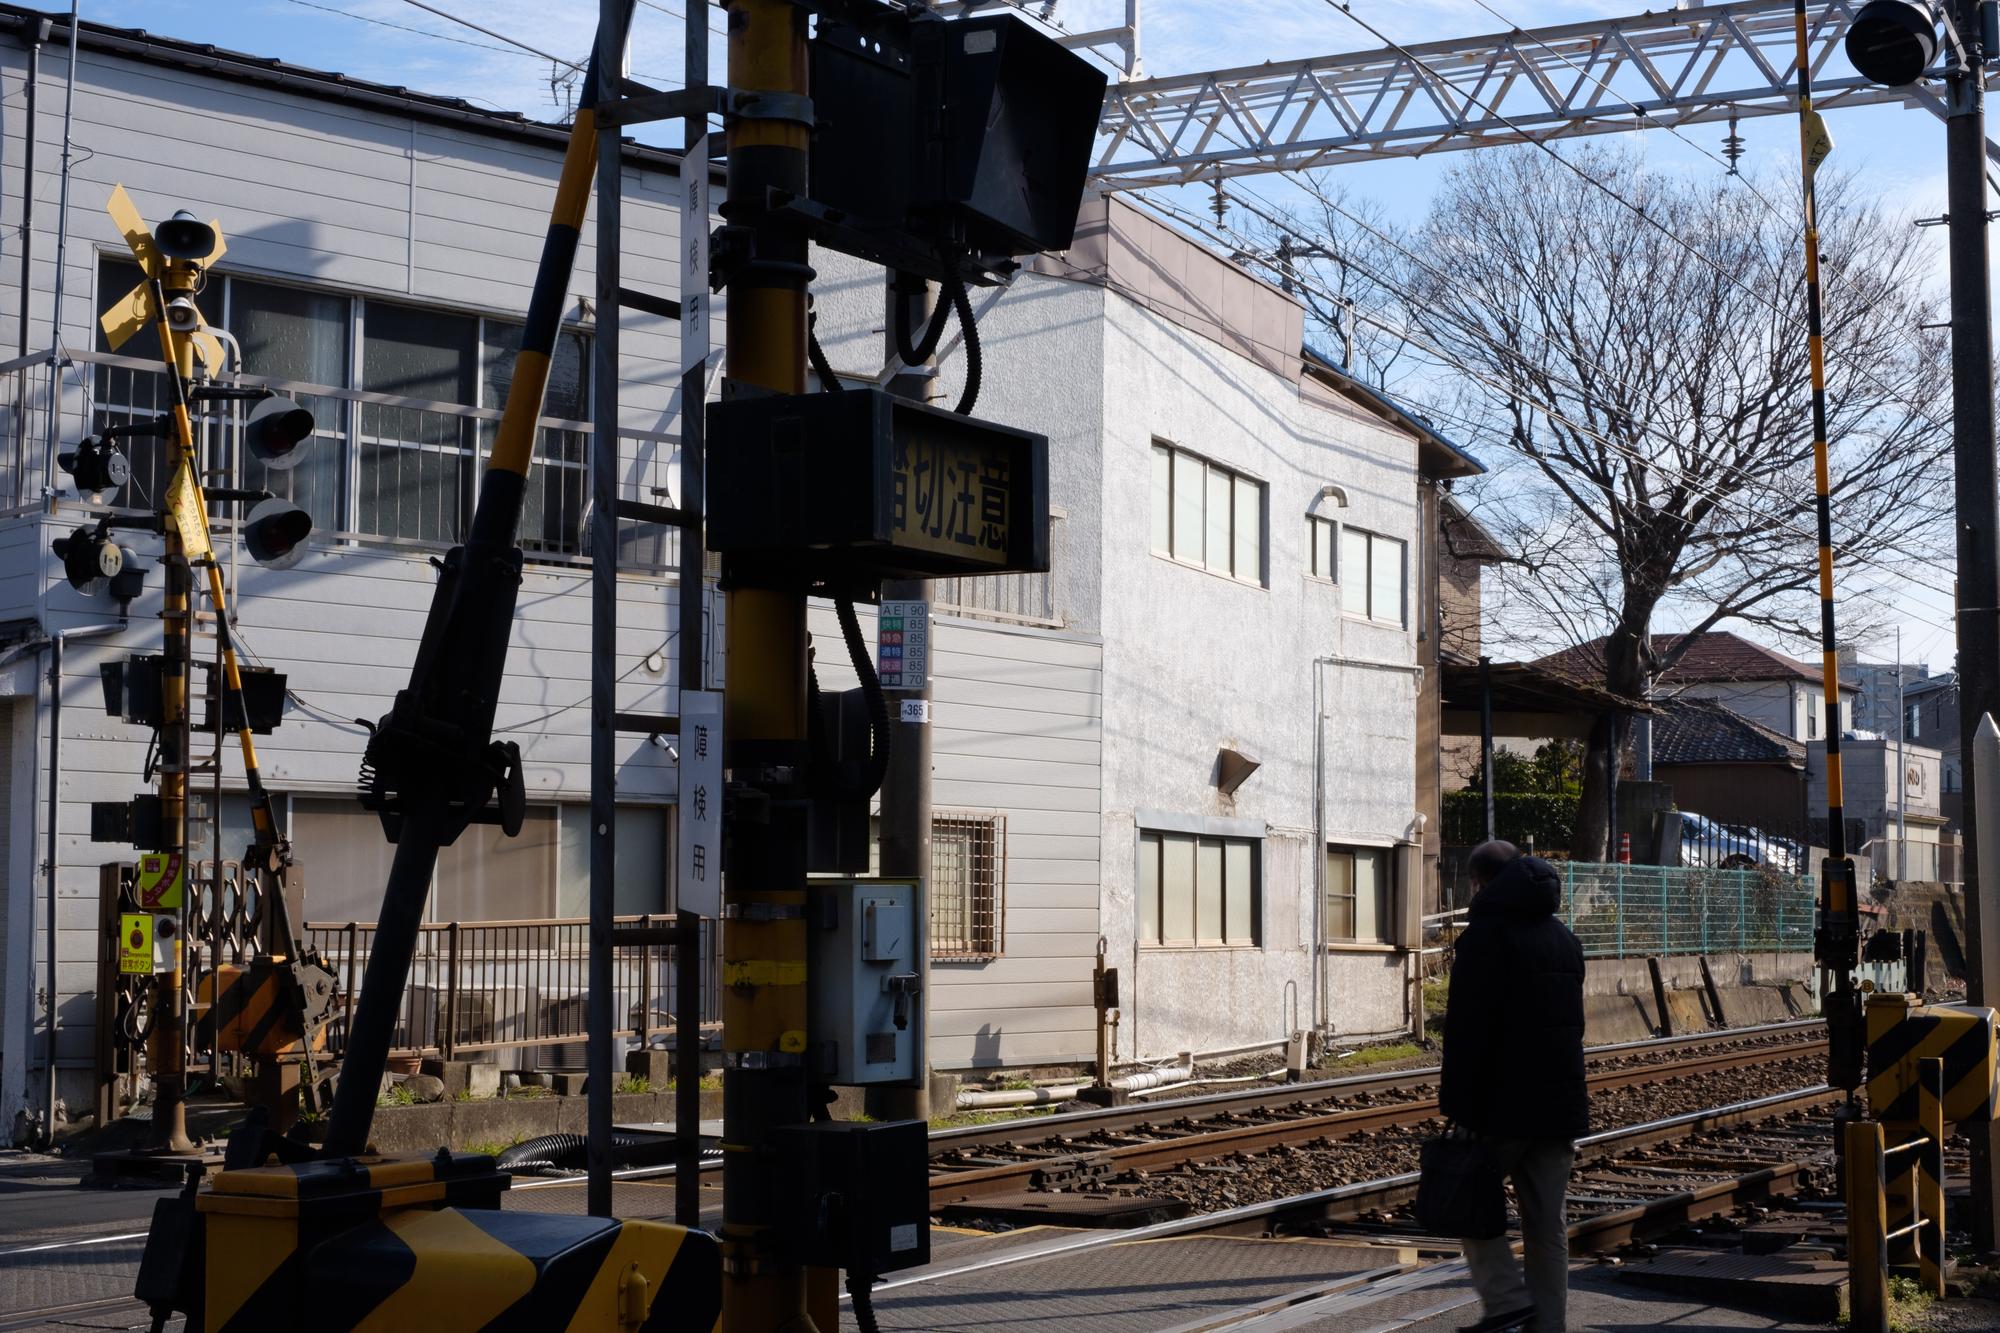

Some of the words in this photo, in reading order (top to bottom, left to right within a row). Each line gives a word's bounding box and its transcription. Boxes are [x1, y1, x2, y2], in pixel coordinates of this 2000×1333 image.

[883, 606, 901, 616] AE
[910, 605, 924, 616] 90
[910, 619, 924, 630] 85
[910, 633, 924, 644] 85
[909, 647, 923, 658] 85
[909, 661, 923, 671] 85
[909, 675, 922, 685] 70
[907, 704, 924, 716] 365
[122, 959, 151, 970] 非常ボタン
[1292, 1032, 1301, 1043] 9
